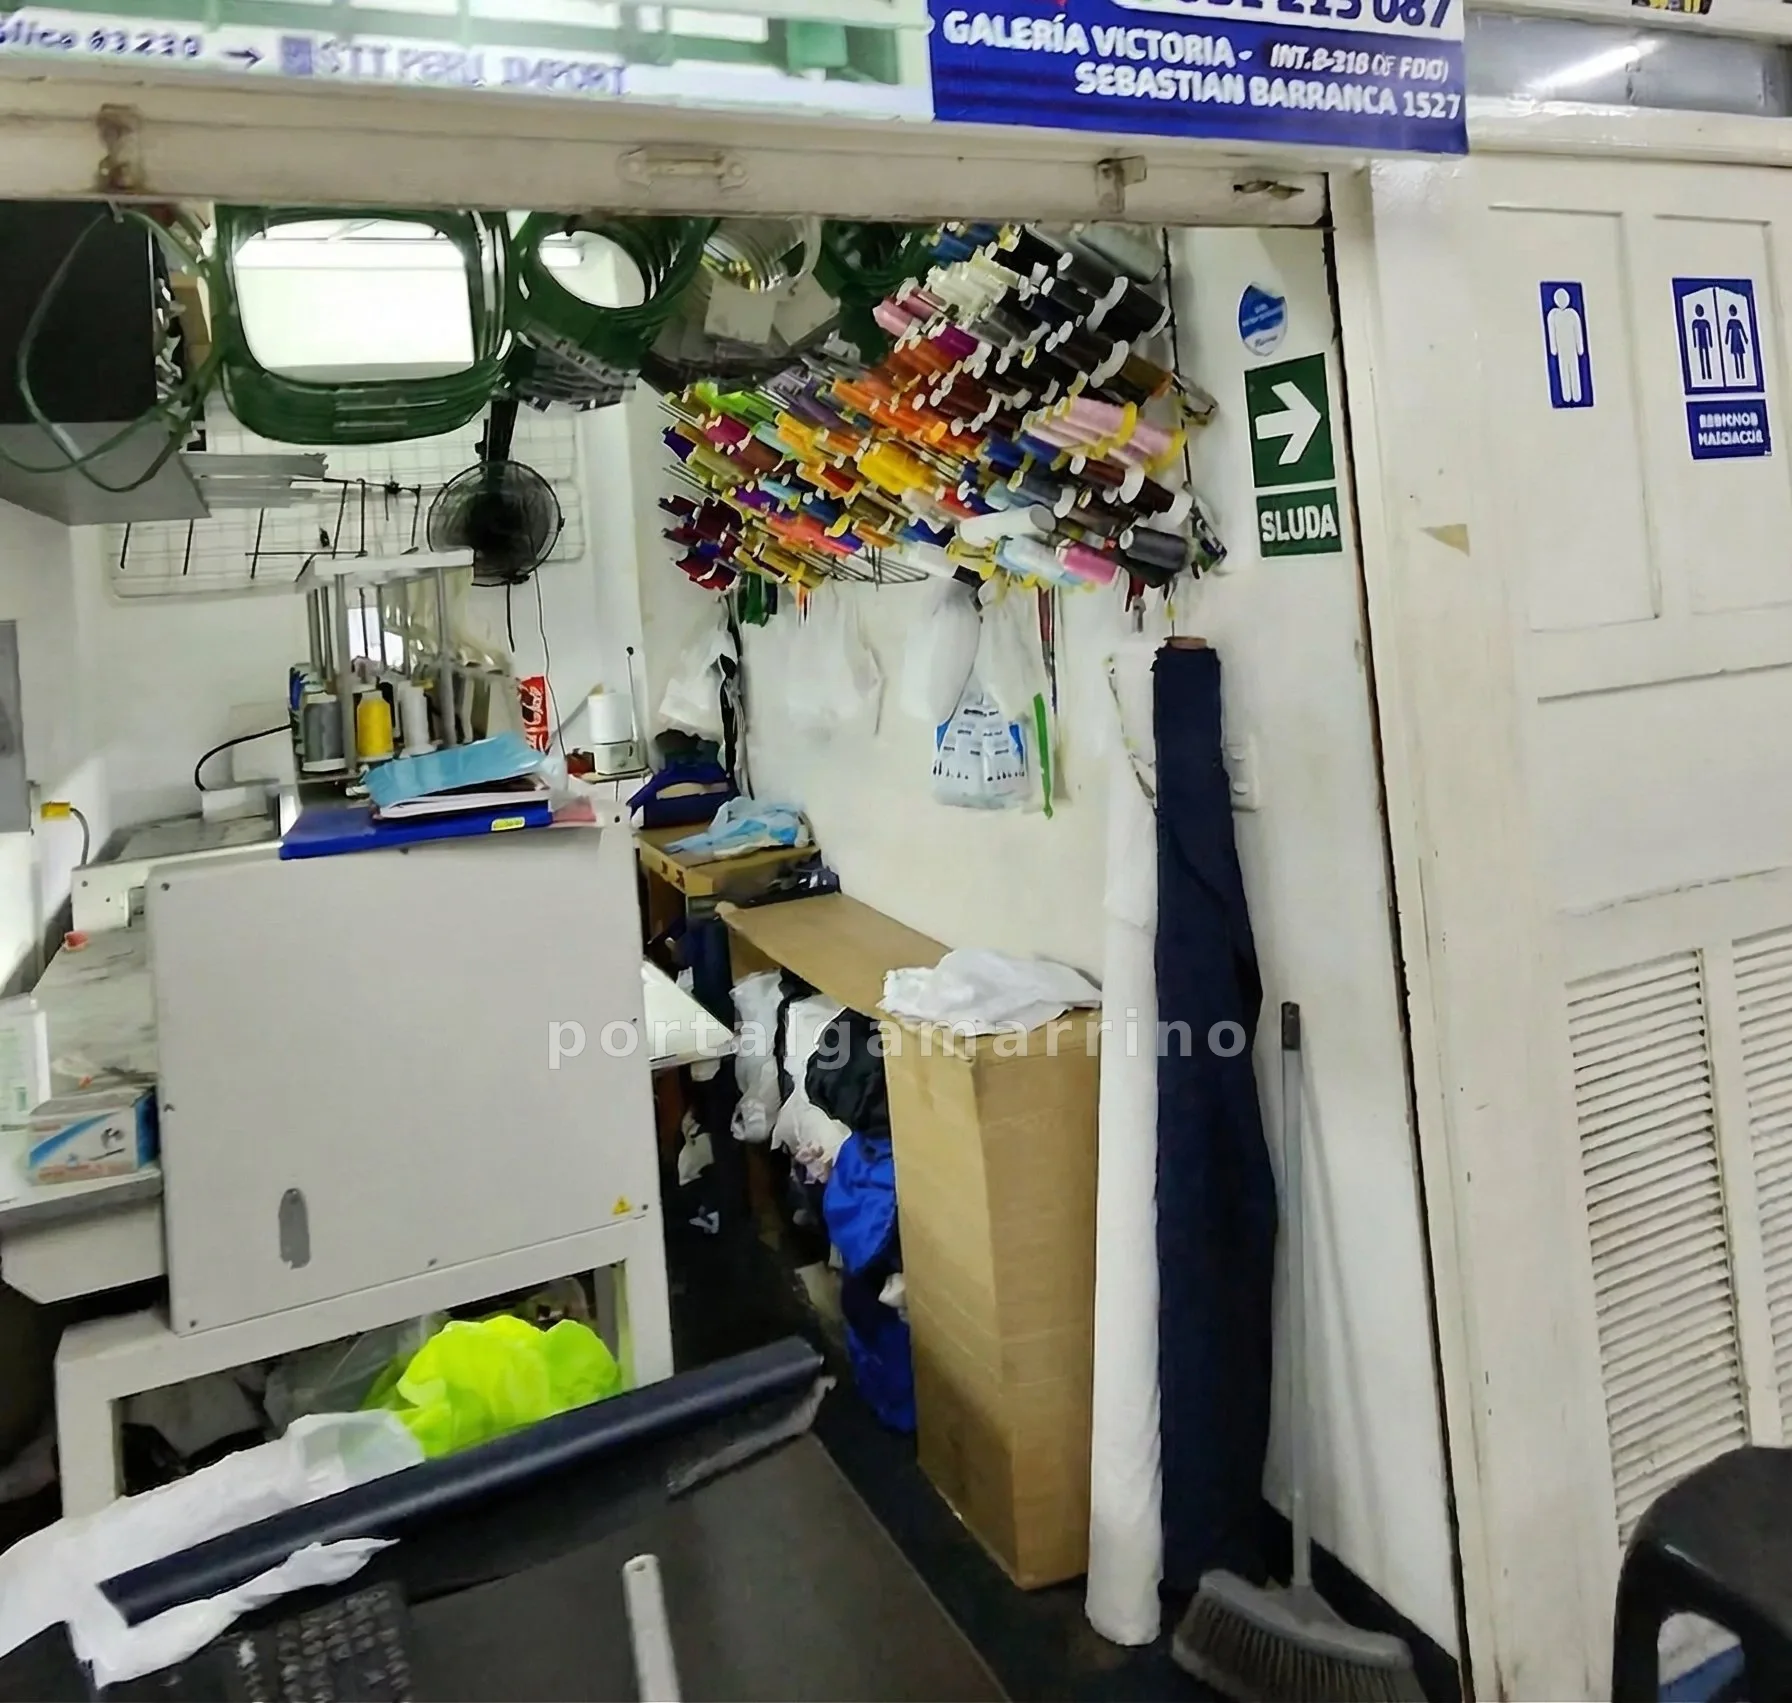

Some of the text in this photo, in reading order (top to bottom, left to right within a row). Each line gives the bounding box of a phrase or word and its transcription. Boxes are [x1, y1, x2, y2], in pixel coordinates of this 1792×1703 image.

[943, 11, 1090, 56] GALERÍA
[1091, 25, 1236, 69] VICTORIA
[1074, 61, 1461, 119] SEBASTIAN BARRANCA 1527
